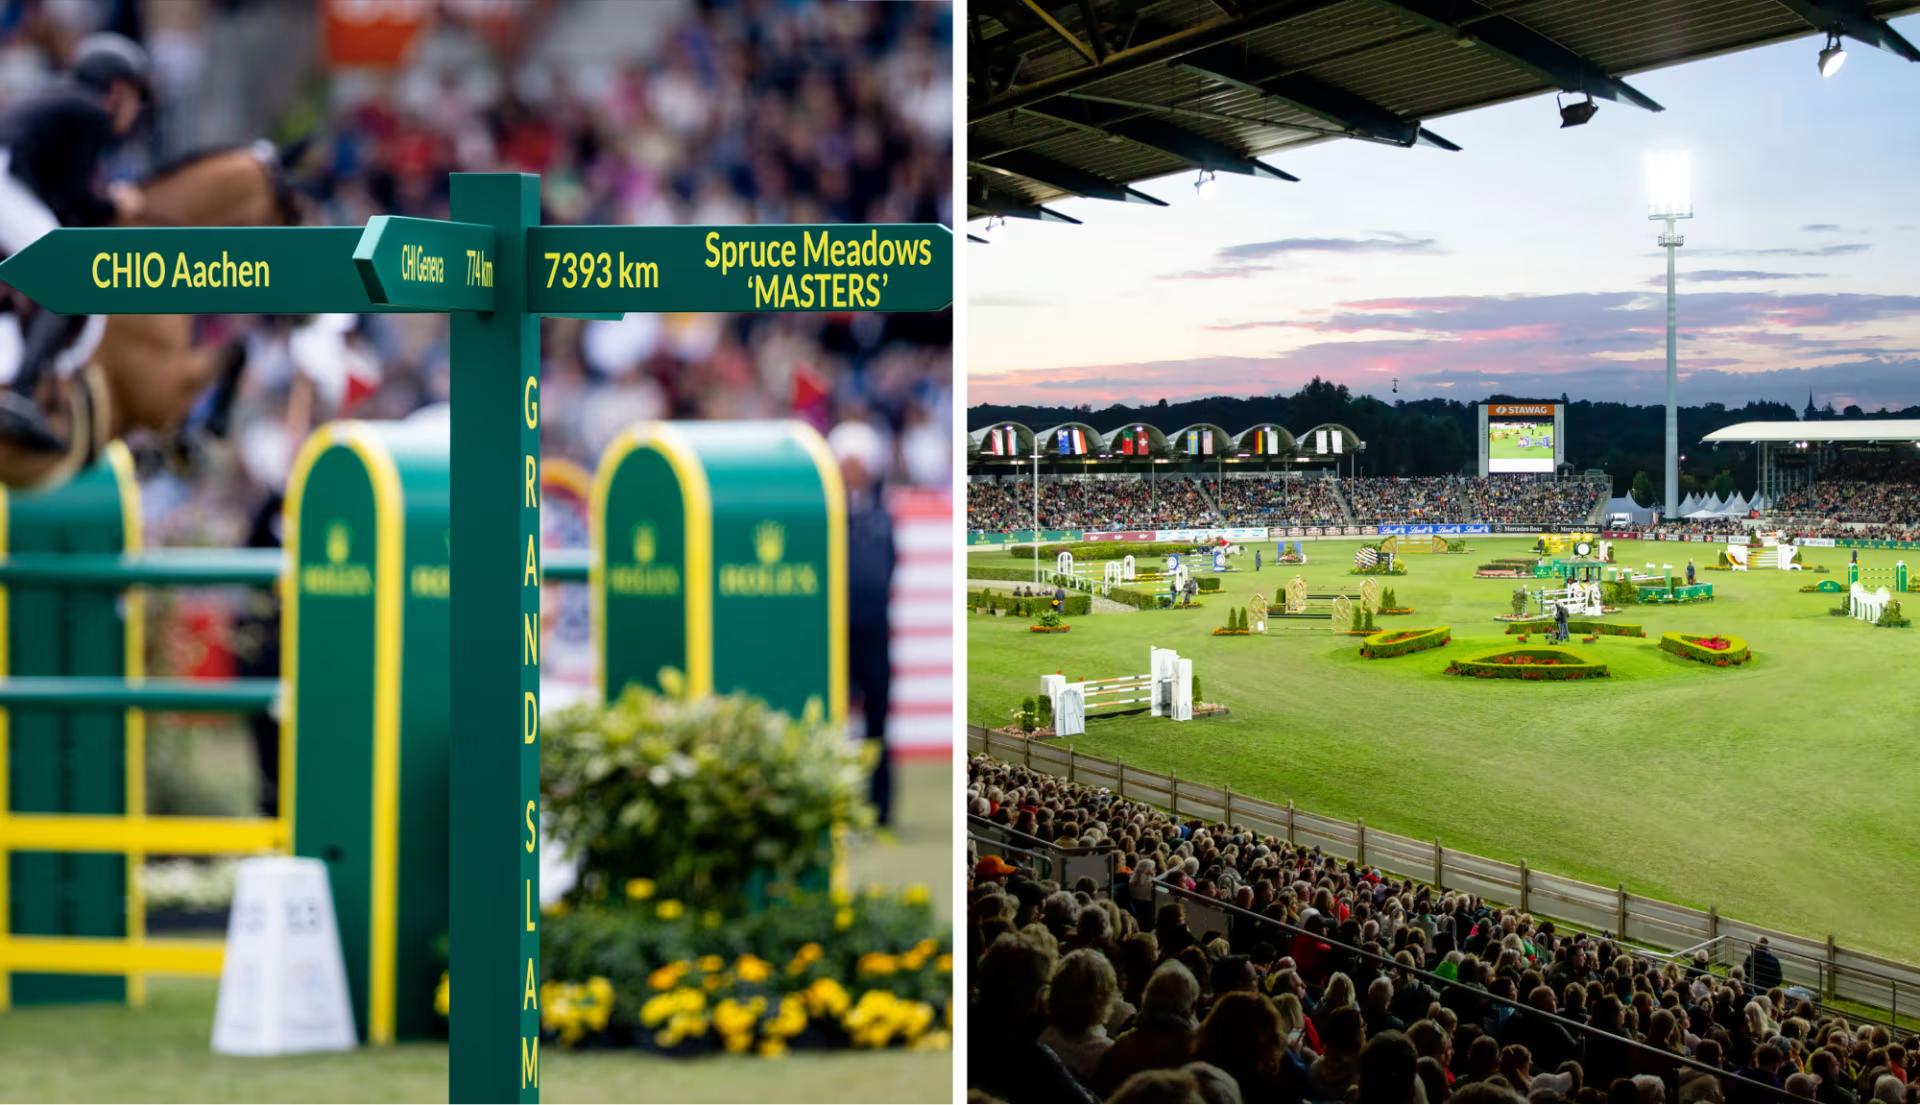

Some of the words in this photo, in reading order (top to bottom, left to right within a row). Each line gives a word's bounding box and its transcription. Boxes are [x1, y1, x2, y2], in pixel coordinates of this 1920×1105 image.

[92, 252, 166, 289] CHIO
[171, 250, 270, 288] Aachen
[401, 244, 417, 281] CHI
[417, 245, 444, 283] Geneva
[466, 249, 481, 287] 774
[481, 250, 493, 288] km
[544, 252, 612, 289] 7393
[619, 251, 659, 289] km
[704, 231, 797, 275] Spruce
[803, 228, 932, 268] Meadows
[1508, 406, 1548, 414] STAWAG
[1504, 525, 1543, 533] Mercedes-Benz
[524, 376, 538, 744] GRAND
[522, 799, 538, 1089] SLAM
